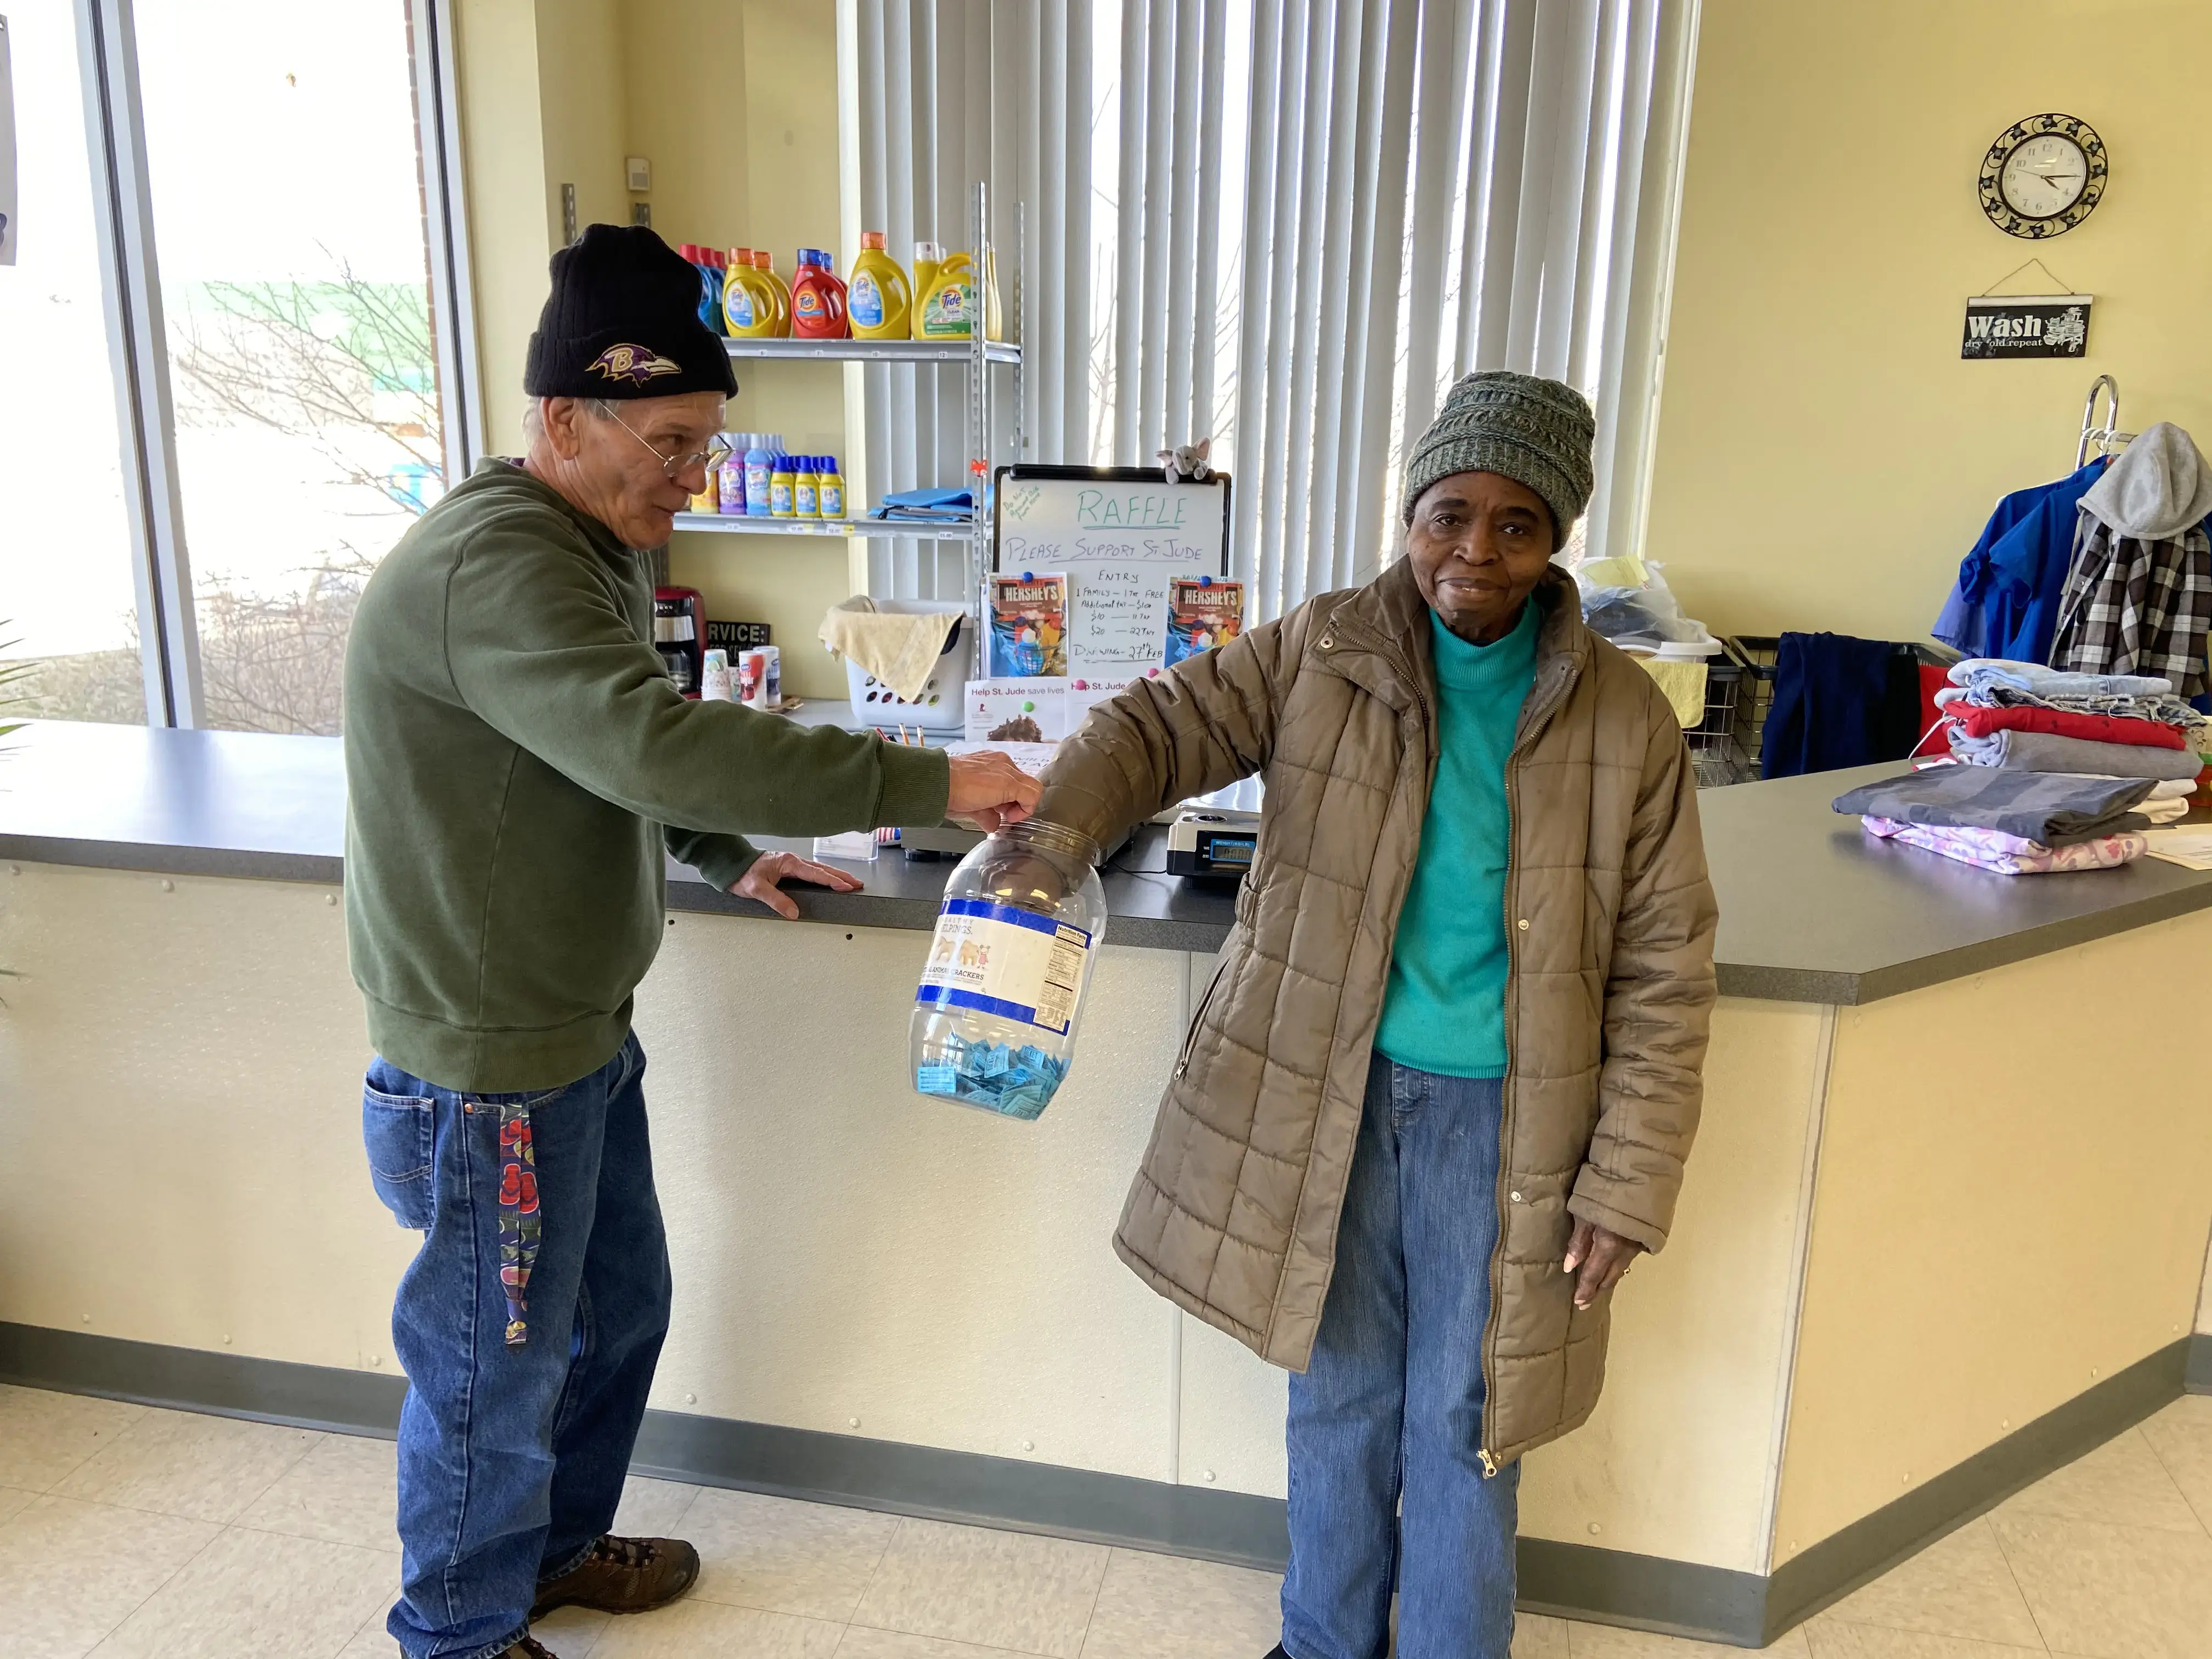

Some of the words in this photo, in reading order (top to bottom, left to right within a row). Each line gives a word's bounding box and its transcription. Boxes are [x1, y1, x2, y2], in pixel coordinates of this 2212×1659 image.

[2042, 144, 2052, 152] 12
[799, 296, 815, 308] Tide
[943, 294, 961, 308] Tide
[1968, 315, 2042, 338] Wash
[1965, 339, 1983, 348] dry
[1987, 338, 2005, 347] fold
[2008, 339, 2043, 348] repeat
[1077, 490, 1187, 524] RAFFLE
[1006, 537, 1062, 561] PLEASE
[1070, 538, 1135, 560] SUPPORT
[1163, 539, 1203, 560] JUDE
[1098, 569, 1138, 583] ENTRY
[1005, 585, 1059, 602] HERSHEY'S
[1083, 587, 1110, 596] FAMILY
[1145, 589, 1164, 599] FREE
[1184, 589, 1237, 606] HERSHEY'S
[708, 623, 765, 643] RVICE:
[1071, 682, 1090, 691] Hp
[972, 689, 990, 697] Help
[943, 917, 974, 925] EALTHY
[940, 924, 973, 934] ELPINGS.
[1058, 925, 1076, 936] Nutrition
[951, 969, 984, 980] CRACKERS
